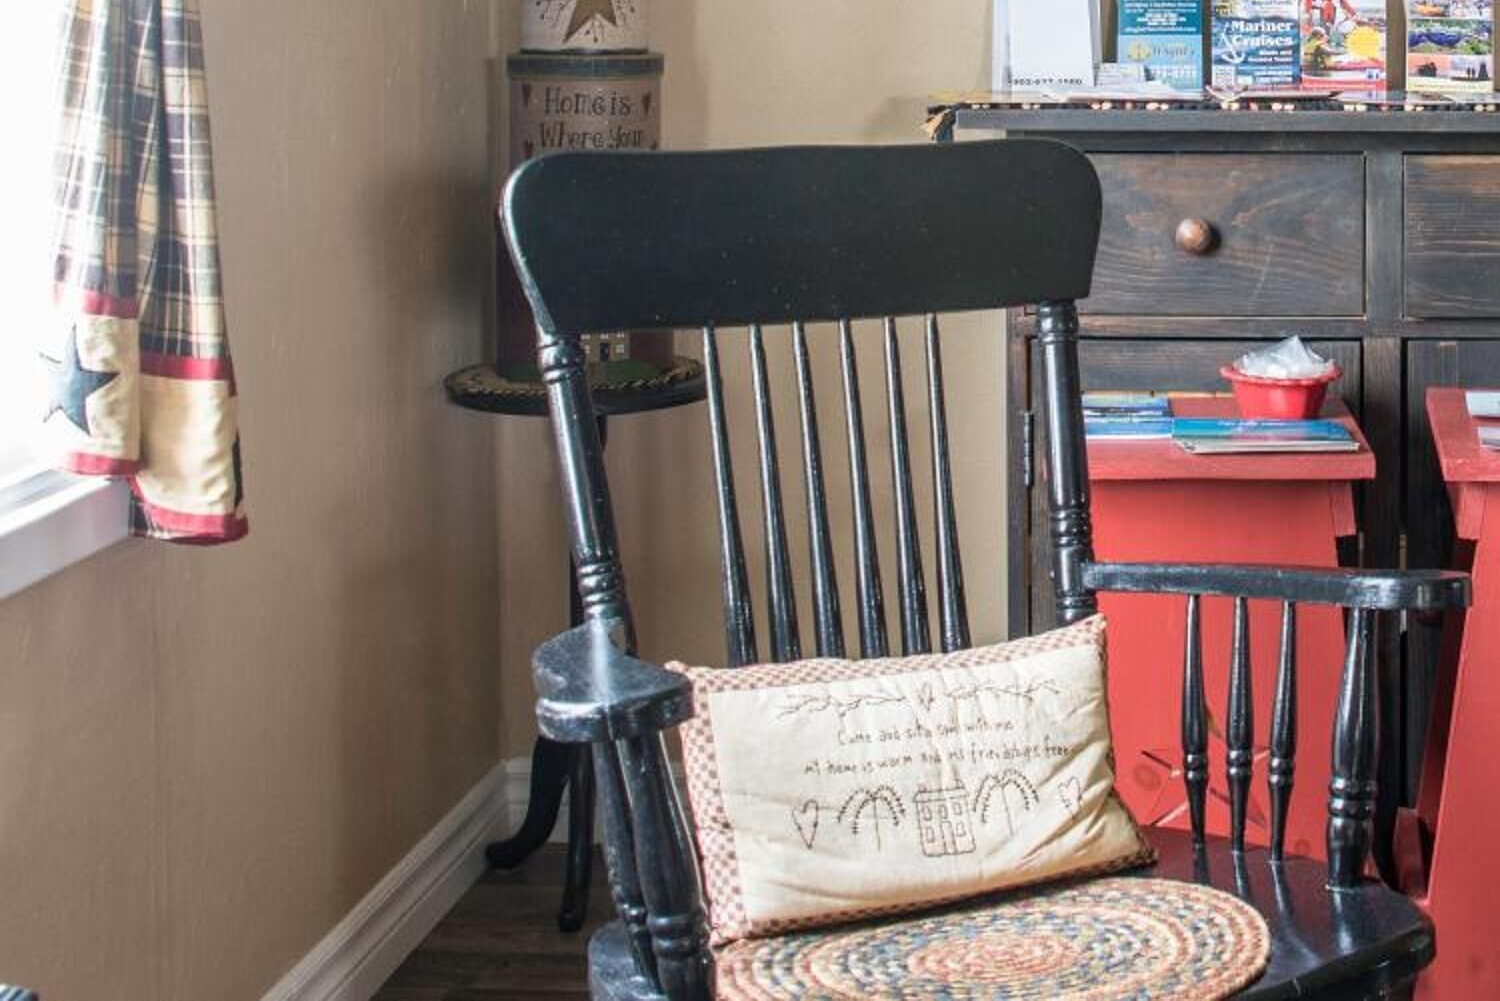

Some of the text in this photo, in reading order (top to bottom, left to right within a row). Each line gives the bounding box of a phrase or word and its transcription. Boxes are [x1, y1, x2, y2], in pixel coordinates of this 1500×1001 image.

[1231, 20, 1293, 32] Mariner
[1231, 34, 1293, 47] Cruises
[545, 86, 632, 115] Home is
[540, 121, 605, 149] Where
